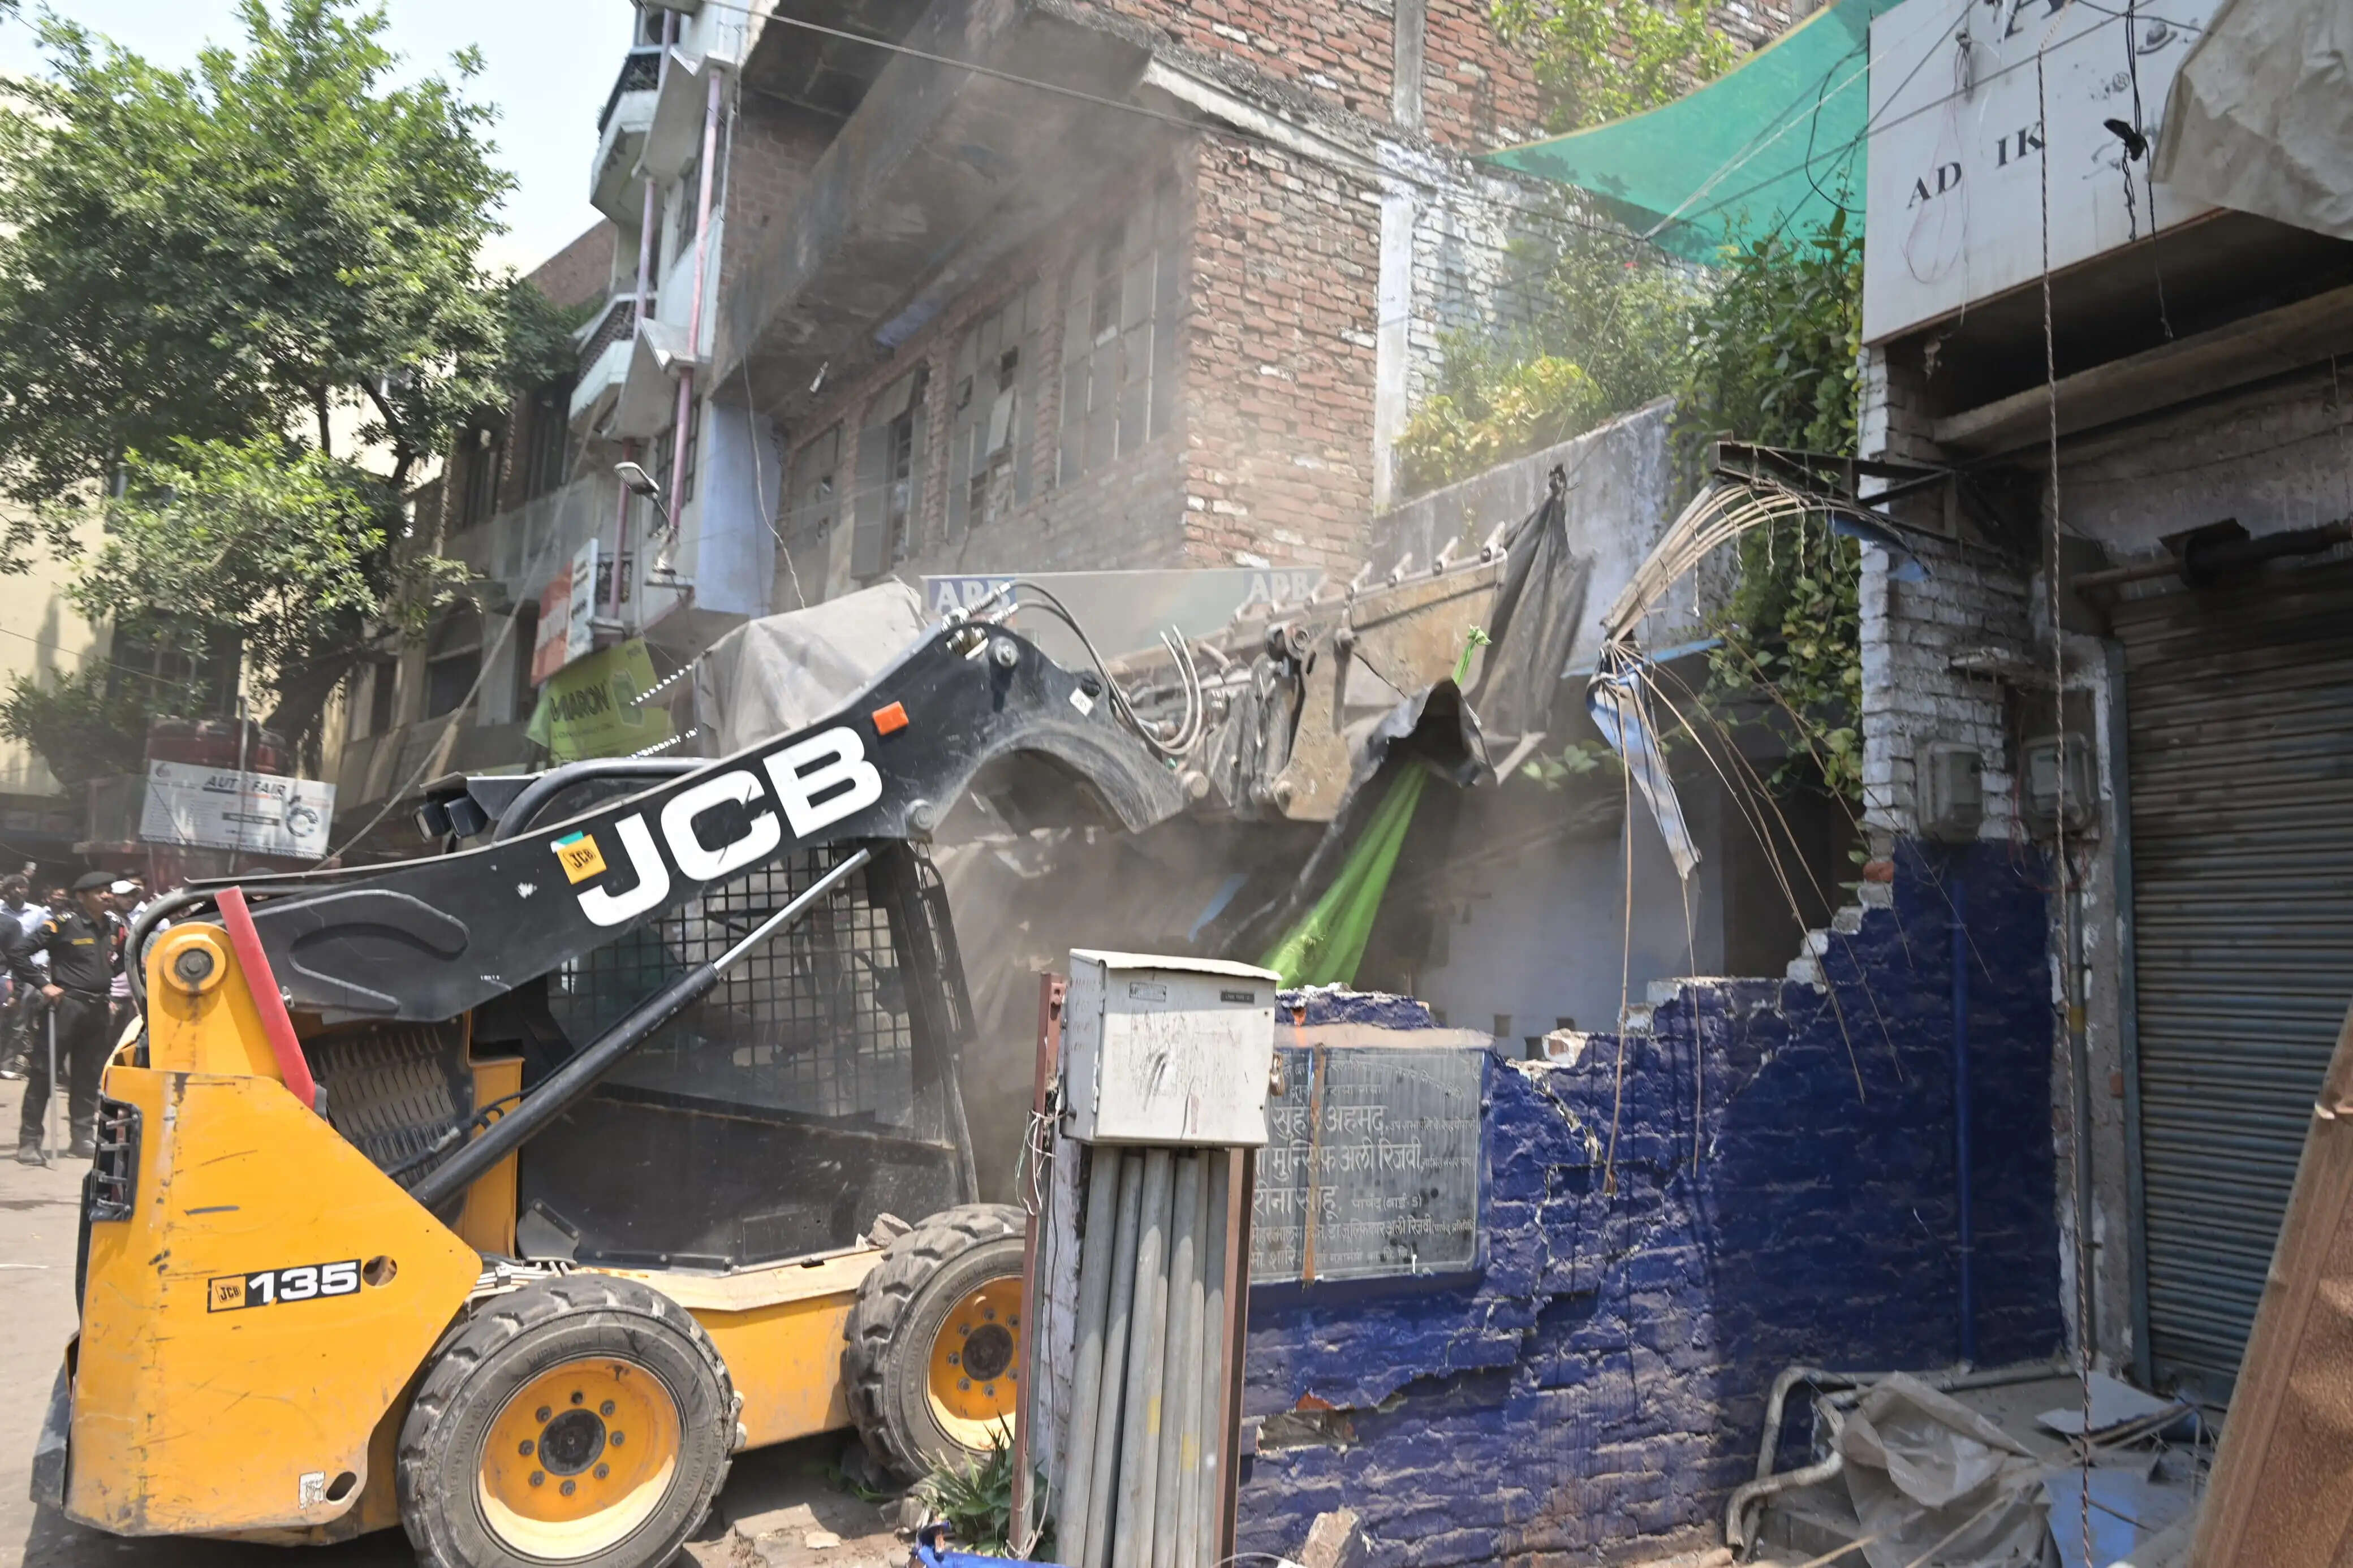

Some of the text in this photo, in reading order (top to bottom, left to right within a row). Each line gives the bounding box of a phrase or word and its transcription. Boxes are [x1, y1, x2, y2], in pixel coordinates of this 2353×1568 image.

[578, 726, 882, 926] JCB
[568, 849, 594, 869] JCB
[1338, 1135, 1374, 1172] अली
[1253, 1180, 1298, 1216] रीना
[220, 1286, 240, 1301] JCB
[249, 1262, 357, 1303] 135
